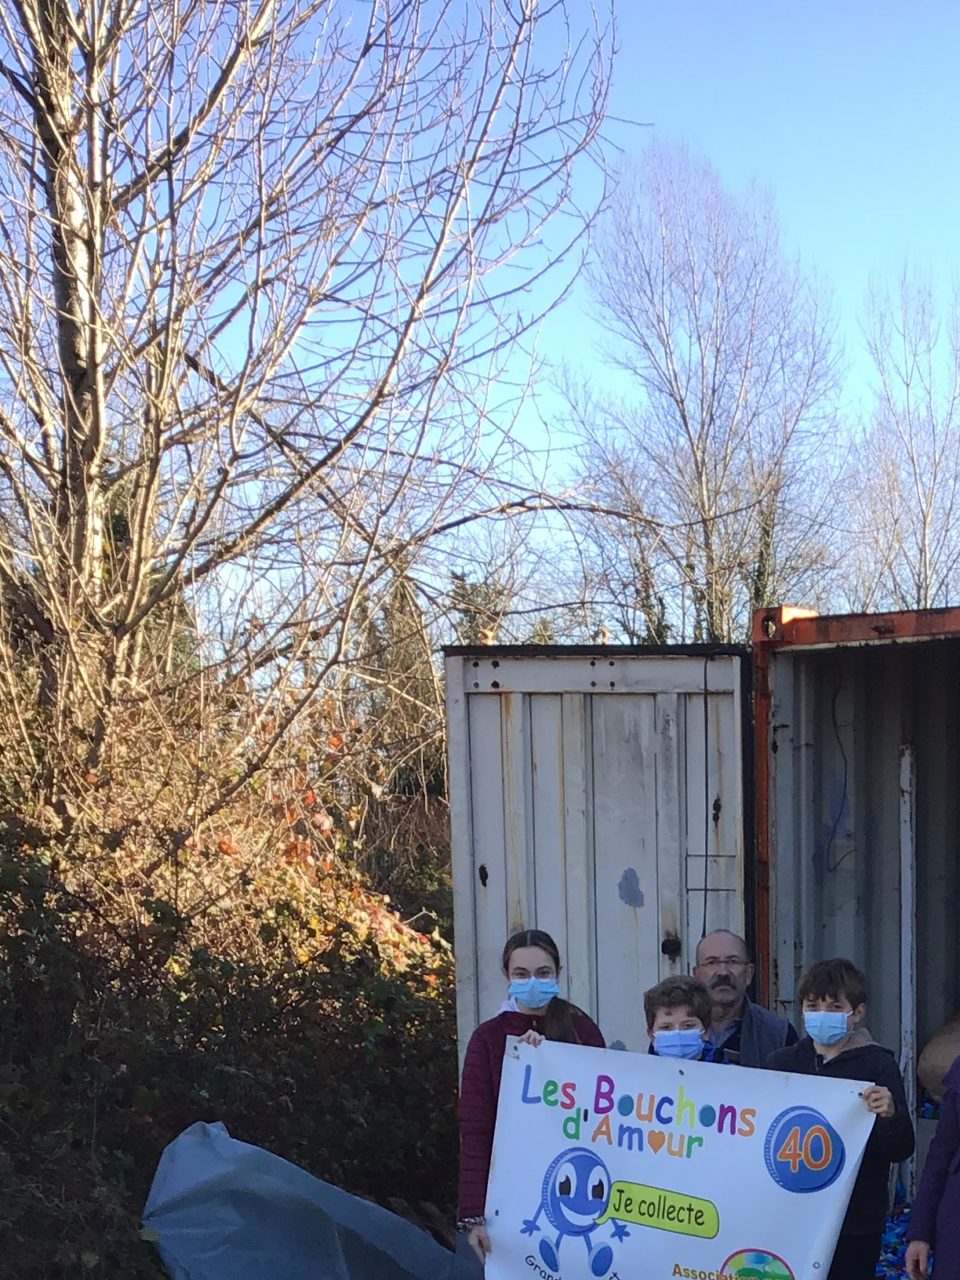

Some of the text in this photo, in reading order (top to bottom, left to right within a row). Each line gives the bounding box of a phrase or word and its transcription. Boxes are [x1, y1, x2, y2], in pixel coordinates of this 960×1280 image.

[521, 1064, 757, 1137] Les Bouchons
[777, 1125, 833, 1173] 40
[613, 1188, 705, 1226] Je collecte
